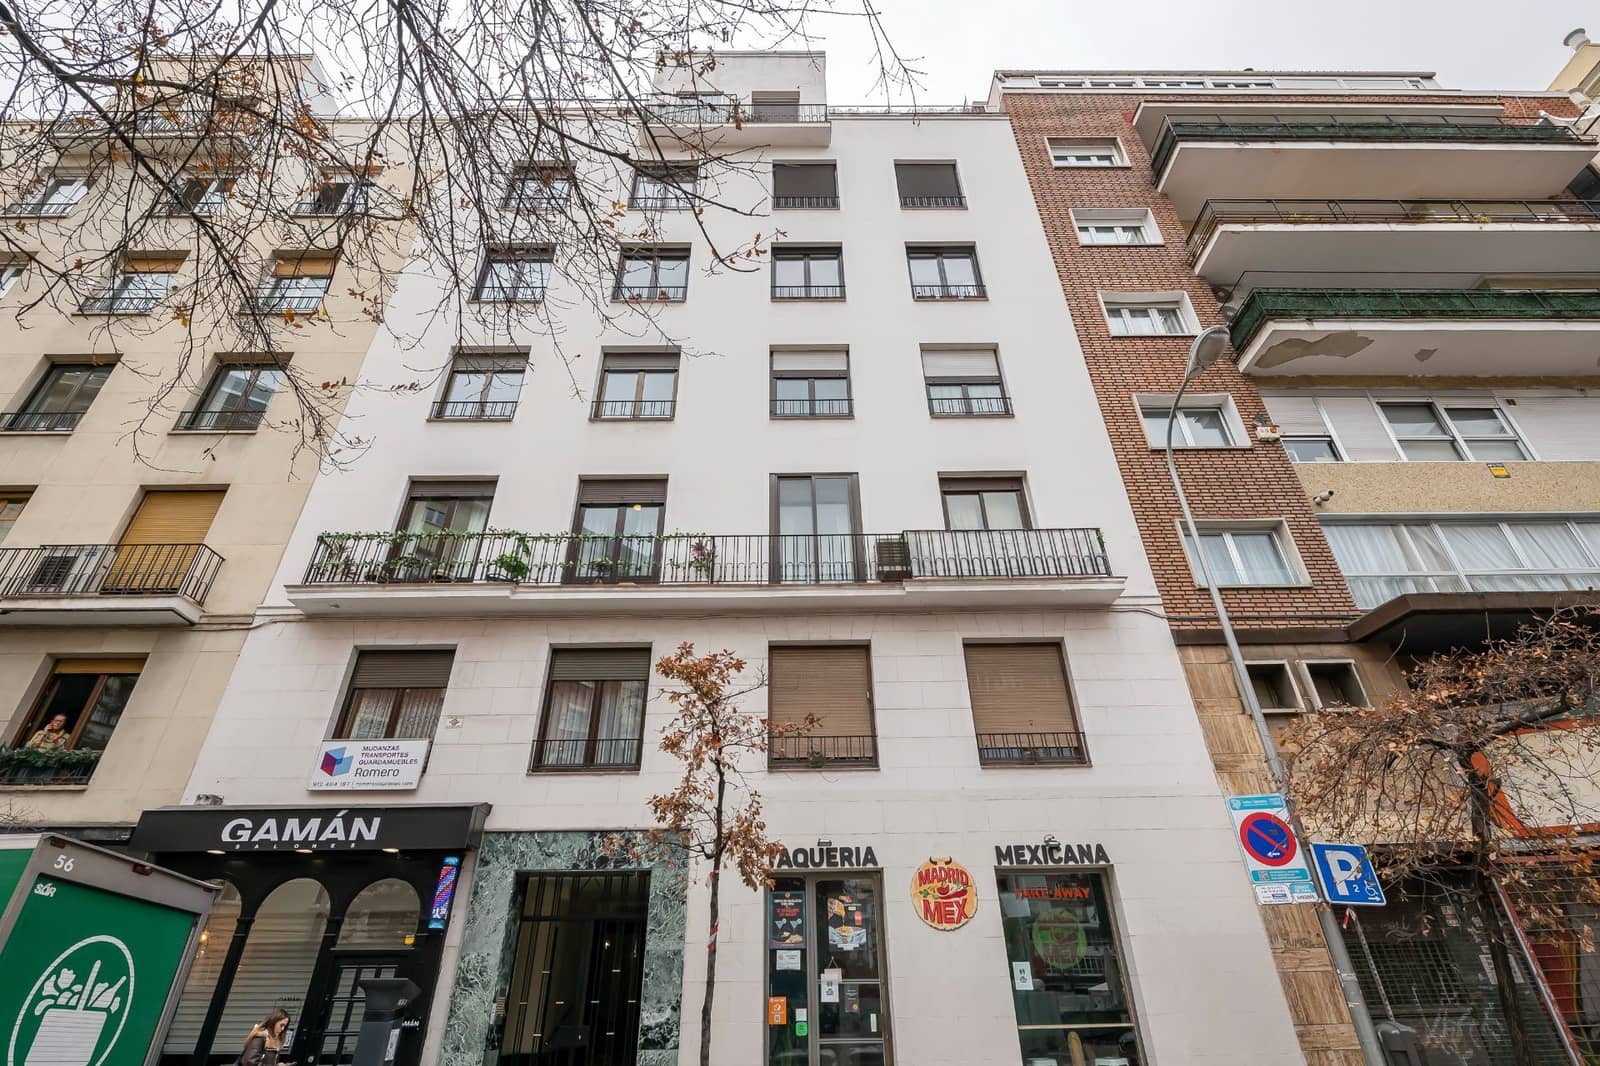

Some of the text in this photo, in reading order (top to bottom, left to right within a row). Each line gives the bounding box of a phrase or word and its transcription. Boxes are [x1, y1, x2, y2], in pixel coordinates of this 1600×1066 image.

[354, 767, 400, 777] Romero
[221, 809, 381, 842] GAMÁN
[54, 854, 75, 872] 56
[994, 843, 1111, 865] MEXICANA
[917, 865, 969, 888] MADRID
[1053, 887, 1090, 899] AWAY
[1352, 884, 1361, 893] 2
[923, 898, 969, 924] MEX
